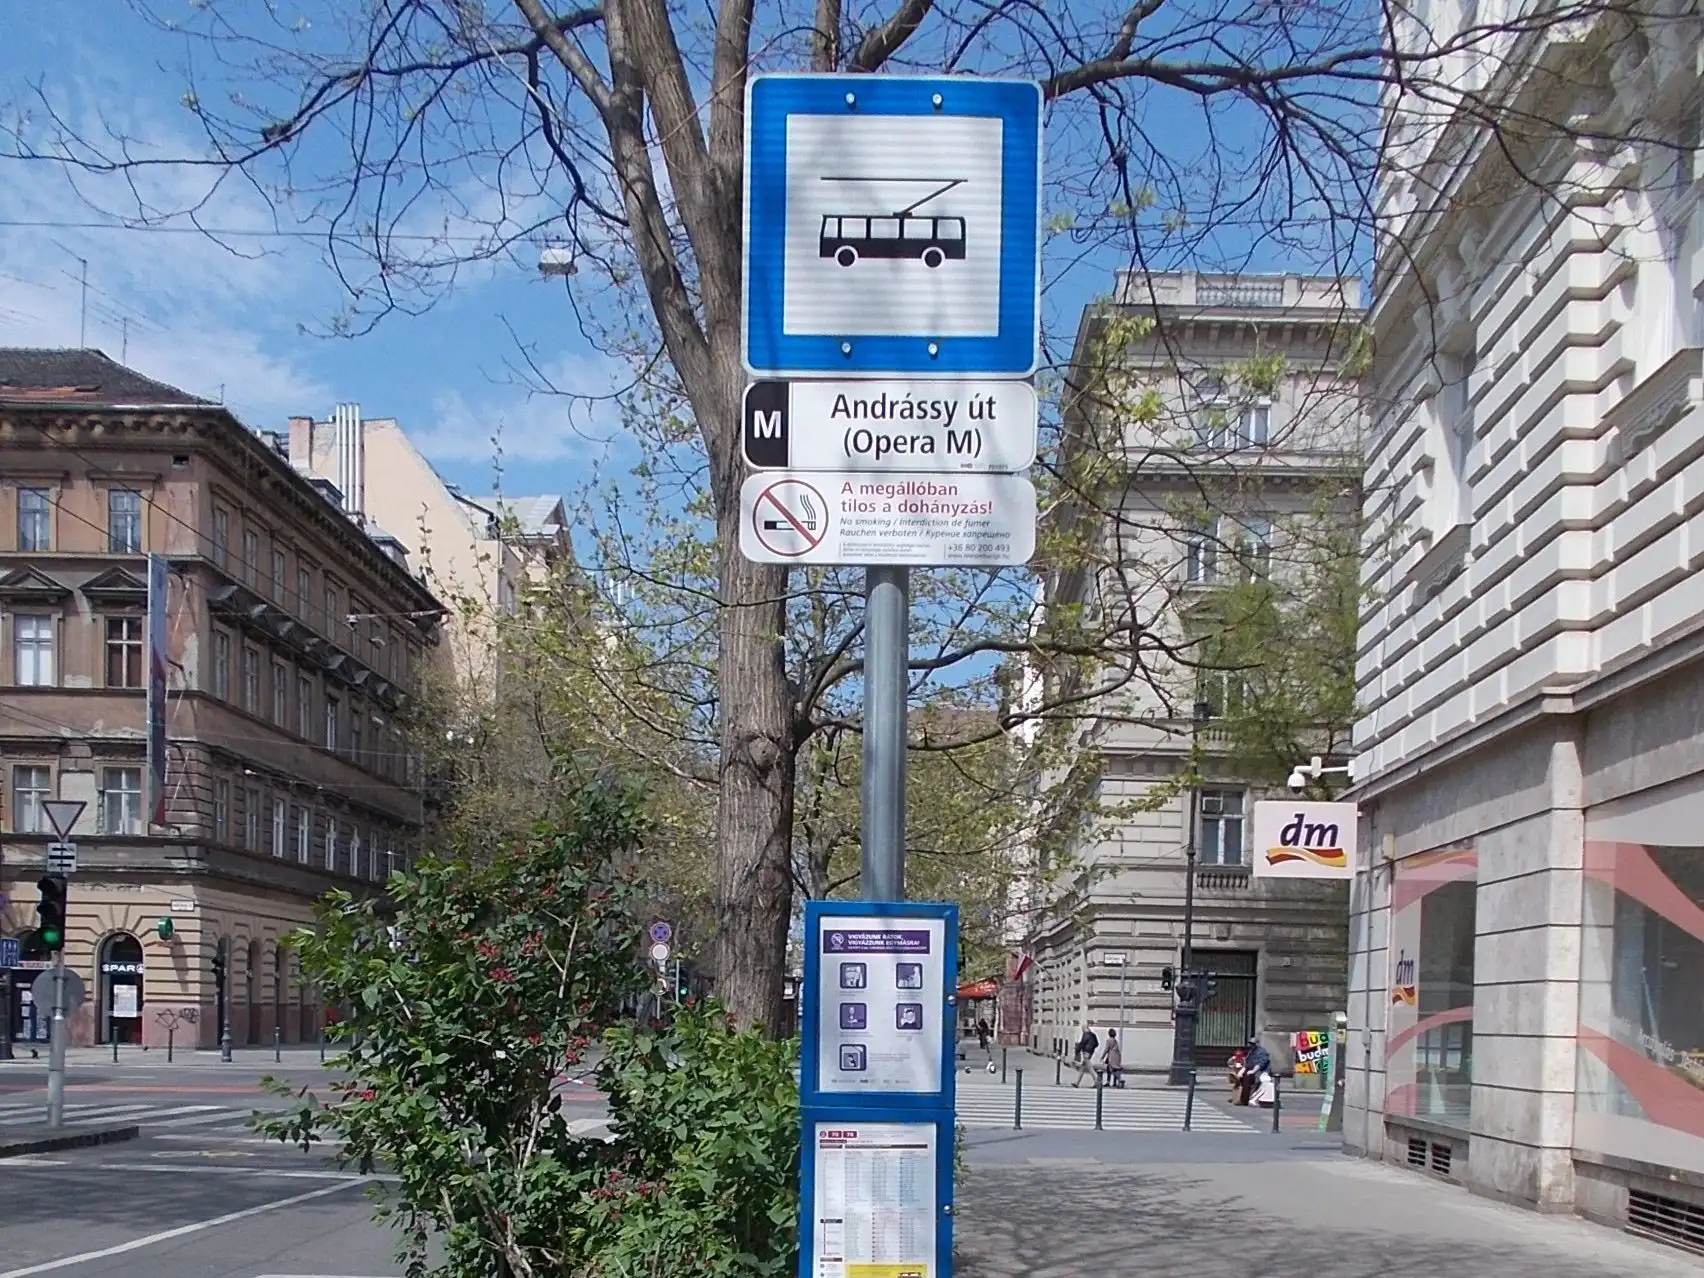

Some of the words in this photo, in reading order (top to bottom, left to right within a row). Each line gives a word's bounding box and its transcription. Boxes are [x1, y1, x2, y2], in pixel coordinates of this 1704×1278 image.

[830, 393, 957, 428] Andrássy
[968, 393, 996, 420] út
[753, 410, 782, 438] M
[843, 428, 936, 460] (Opera
[947, 429, 982, 458] M)
[841, 481, 853, 494] A
[860, 481, 958, 499] megállóban
[841, 501, 876, 514] tilos
[882, 504, 892, 514] a
[899, 501, 993, 516] dohányzás!
[855, 518, 891, 528] smoking
[899, 518, 949, 527] Interdiction
[951, 519, 962, 527] de
[964, 520, 991, 529] fumer
[879, 529, 918, 537] verboten
[1280, 813, 1339, 847] dm
[102, 964, 135, 972] SPAR
